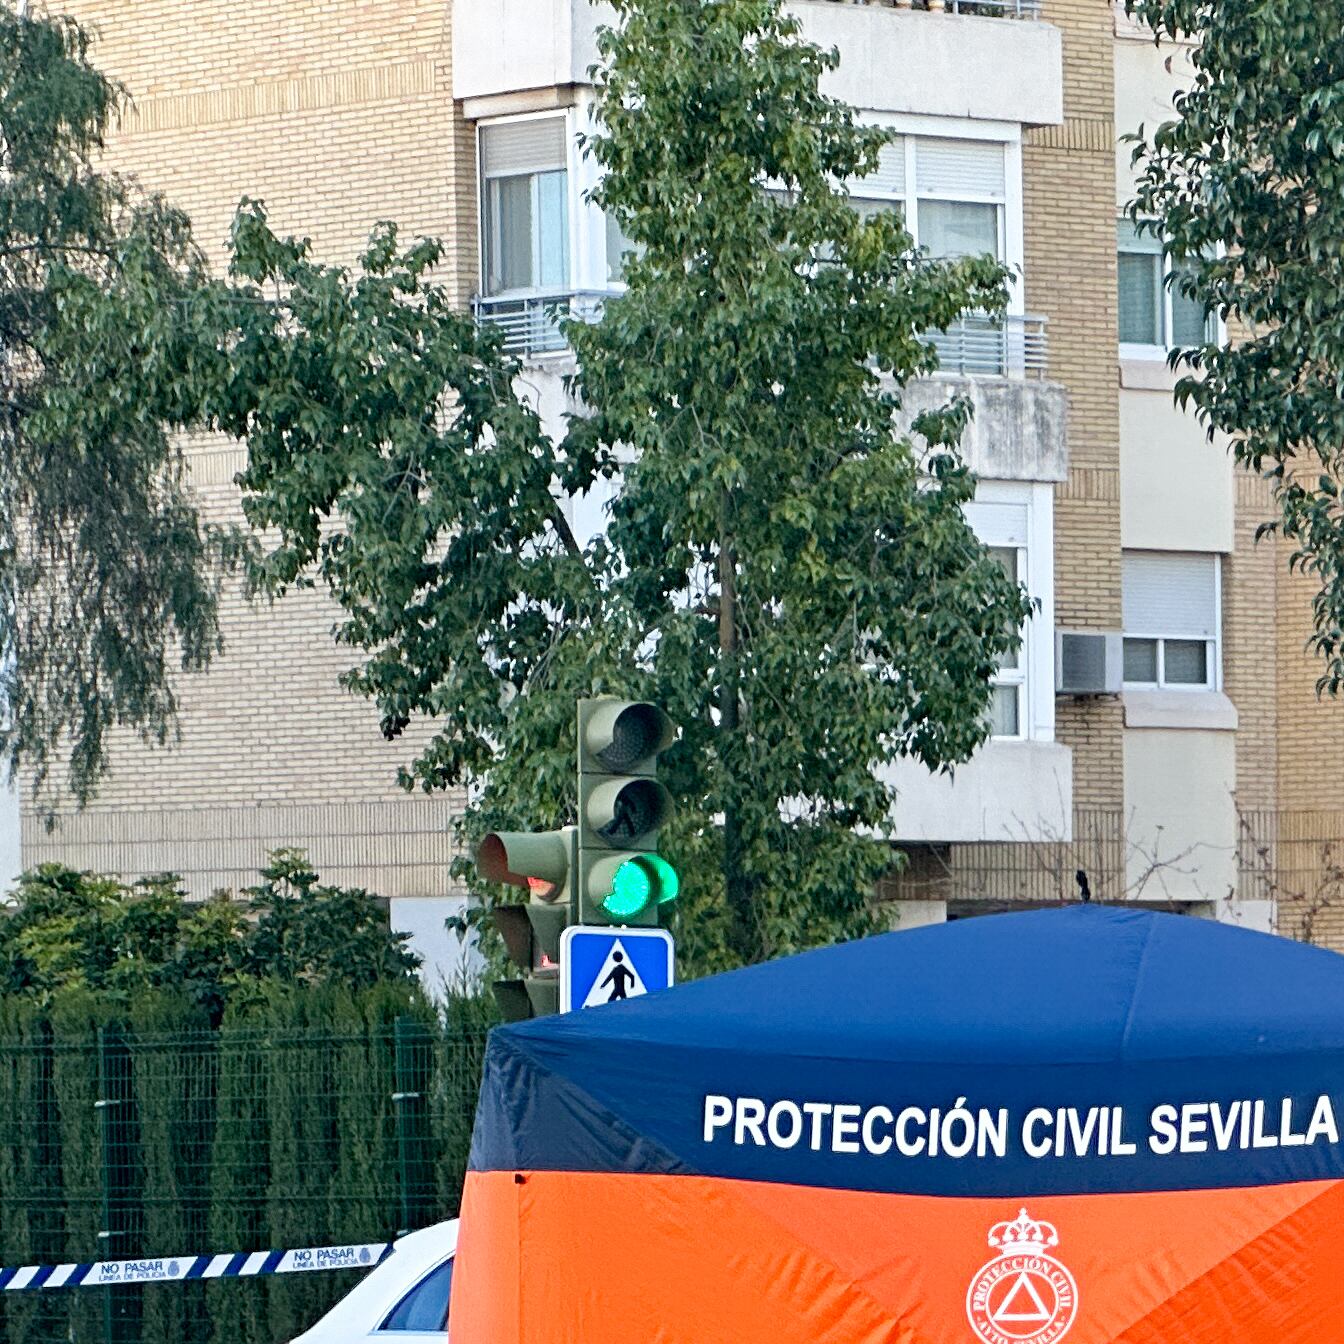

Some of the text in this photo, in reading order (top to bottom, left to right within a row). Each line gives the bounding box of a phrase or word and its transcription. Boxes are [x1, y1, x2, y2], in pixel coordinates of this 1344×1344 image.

[703, 1094, 1339, 1158] PROTECCIÓN CIVIL SEVILLA
[101, 1261, 163, 1274] NO PASAR
[293, 1247, 354, 1261] NO PASAR
[973, 1255, 1072, 1312] PROTECCIÓN CIVIL
